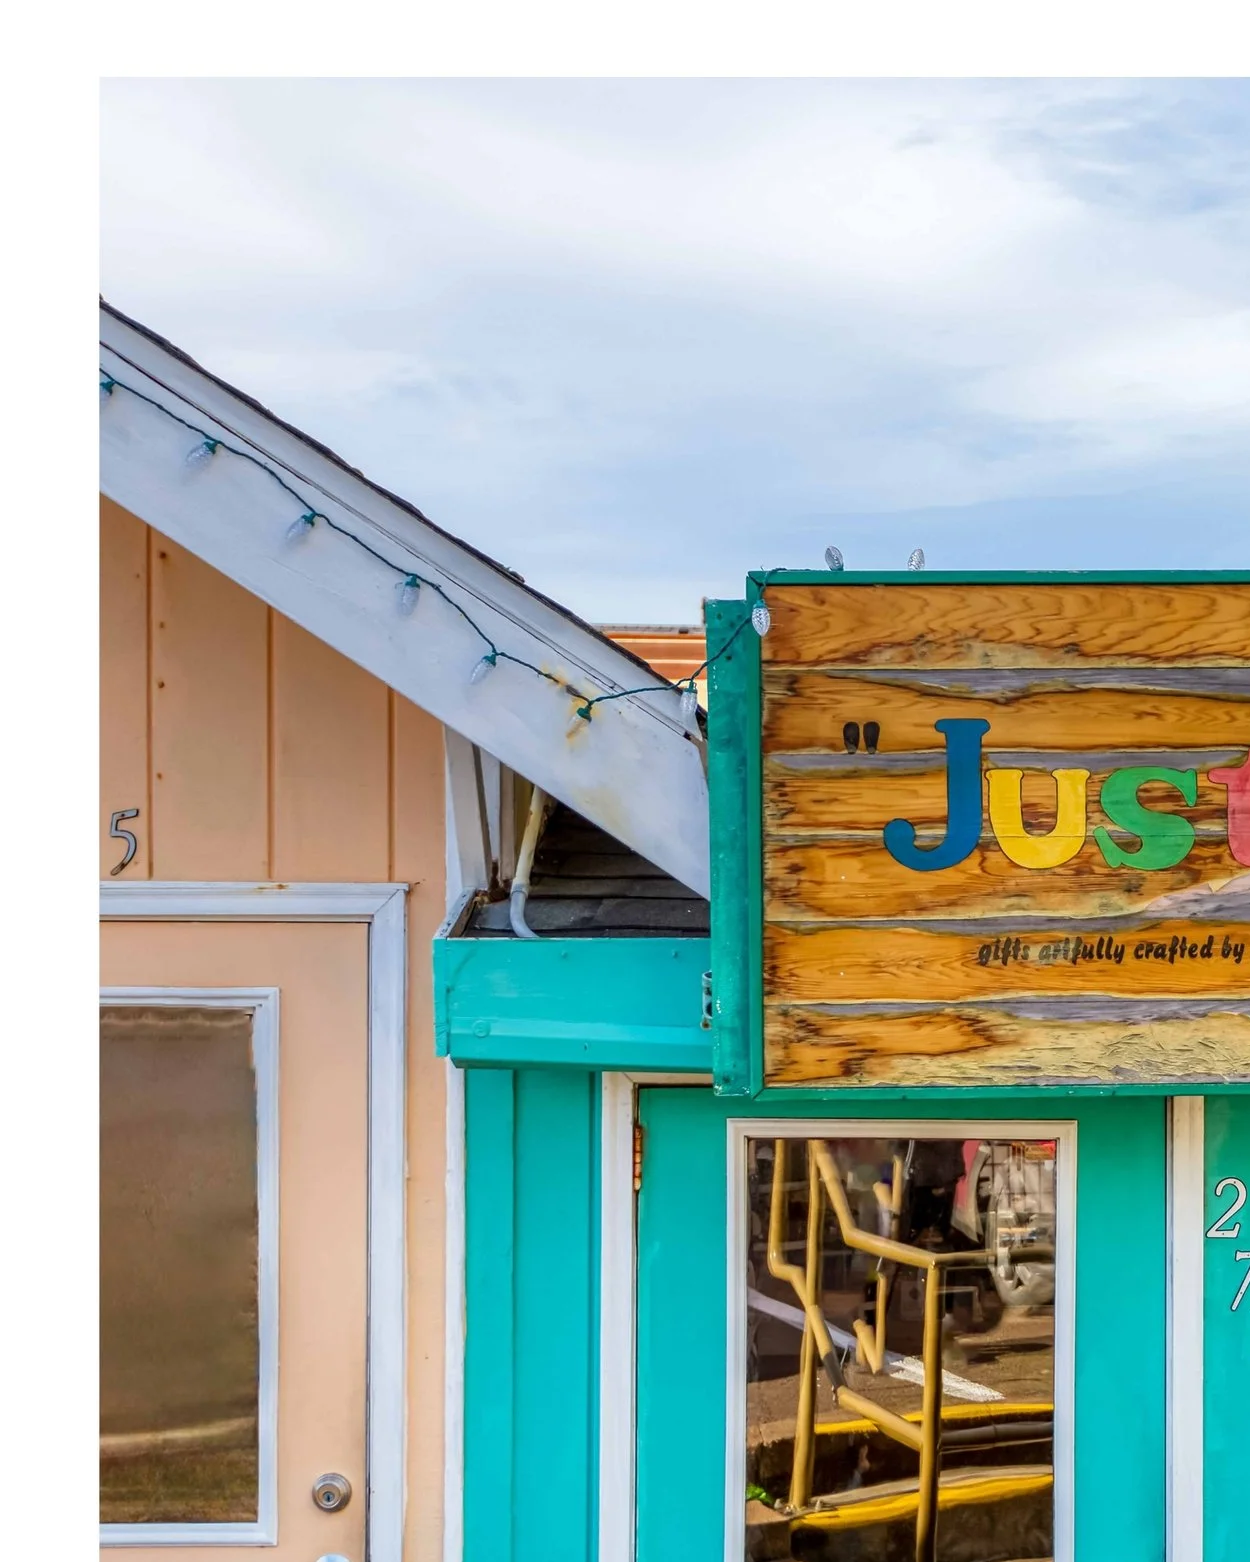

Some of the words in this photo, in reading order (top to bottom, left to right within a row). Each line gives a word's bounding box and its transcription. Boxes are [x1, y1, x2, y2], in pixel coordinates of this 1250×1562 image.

[109, 808, 139, 876] 5
[977, 936, 1030, 966] gifts
[1038, 936, 1126, 965] artfully
[1133, 934, 1215, 965] crafted
[1221, 934, 1246, 965] by
